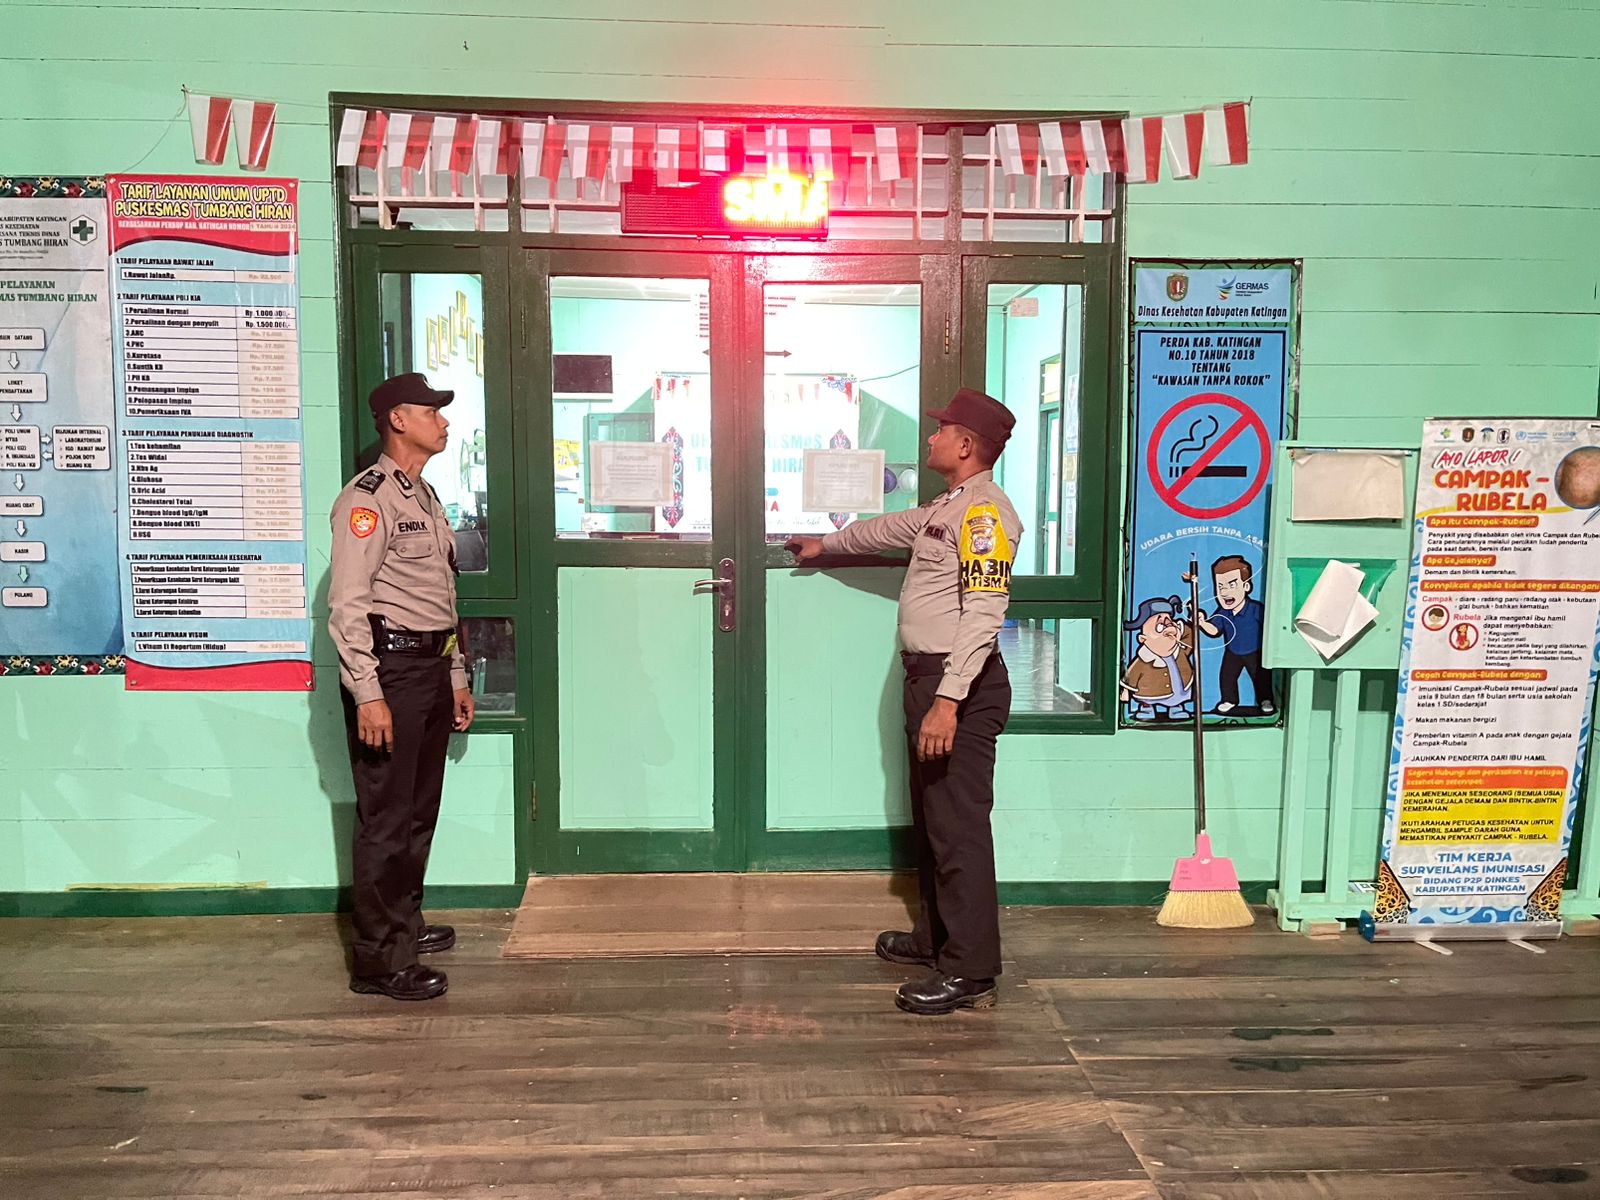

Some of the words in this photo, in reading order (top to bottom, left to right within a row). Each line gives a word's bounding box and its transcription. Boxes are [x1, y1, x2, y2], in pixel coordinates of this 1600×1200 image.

[121, 183, 154, 199] TARIF
[155, 184, 208, 201] LAYANAN
[212, 186, 249, 201] UMUM
[253, 187, 286, 202] UPTD
[115, 201, 190, 217] PUSKESMAS
[194, 203, 251, 219] TUMBANG
[255, 204, 292, 220] HIRAN
[1138, 306, 1159, 316] Dinas
[1161, 306, 1203, 317] Kesehatan
[1205, 306, 1248, 319] Kabupaten
[1251, 306, 1287, 319] Katingan
[1160, 337, 1189, 347] PERDA
[1193, 337, 1213, 347] KAB.
[1217, 337, 1261, 347] KATINGAN
[1169, 350, 1196, 360] NO.10
[1200, 350, 1228, 360] TAHUN
[1232, 350, 1255, 360] 2018
[1192, 363, 1231, 372] TENTANG
[1203, 375, 1231, 385] TANPA
[1436, 451, 1463, 468] AYO
[1467, 450, 1508, 464] LAPOR
[1434, 470, 1531, 488] CAMPAK
[1456, 493, 1547, 511] RUBELA
[1141, 532, 1173, 550] UDARA
[1176, 527, 1209, 536] BERSIH
[1212, 526, 1242, 538] TANPA
[1426, 557, 1442, 565] Apa
[1444, 557, 1492, 565] Gejalanya?
[1438, 853, 1465, 863] TIM
[1467, 853, 1511, 863] KERJA
[1401, 866, 1478, 875] SURVEILANS
[1482, 865, 1545, 873] IMUNISASI
[1415, 885, 1473, 893] KABUPATEN
